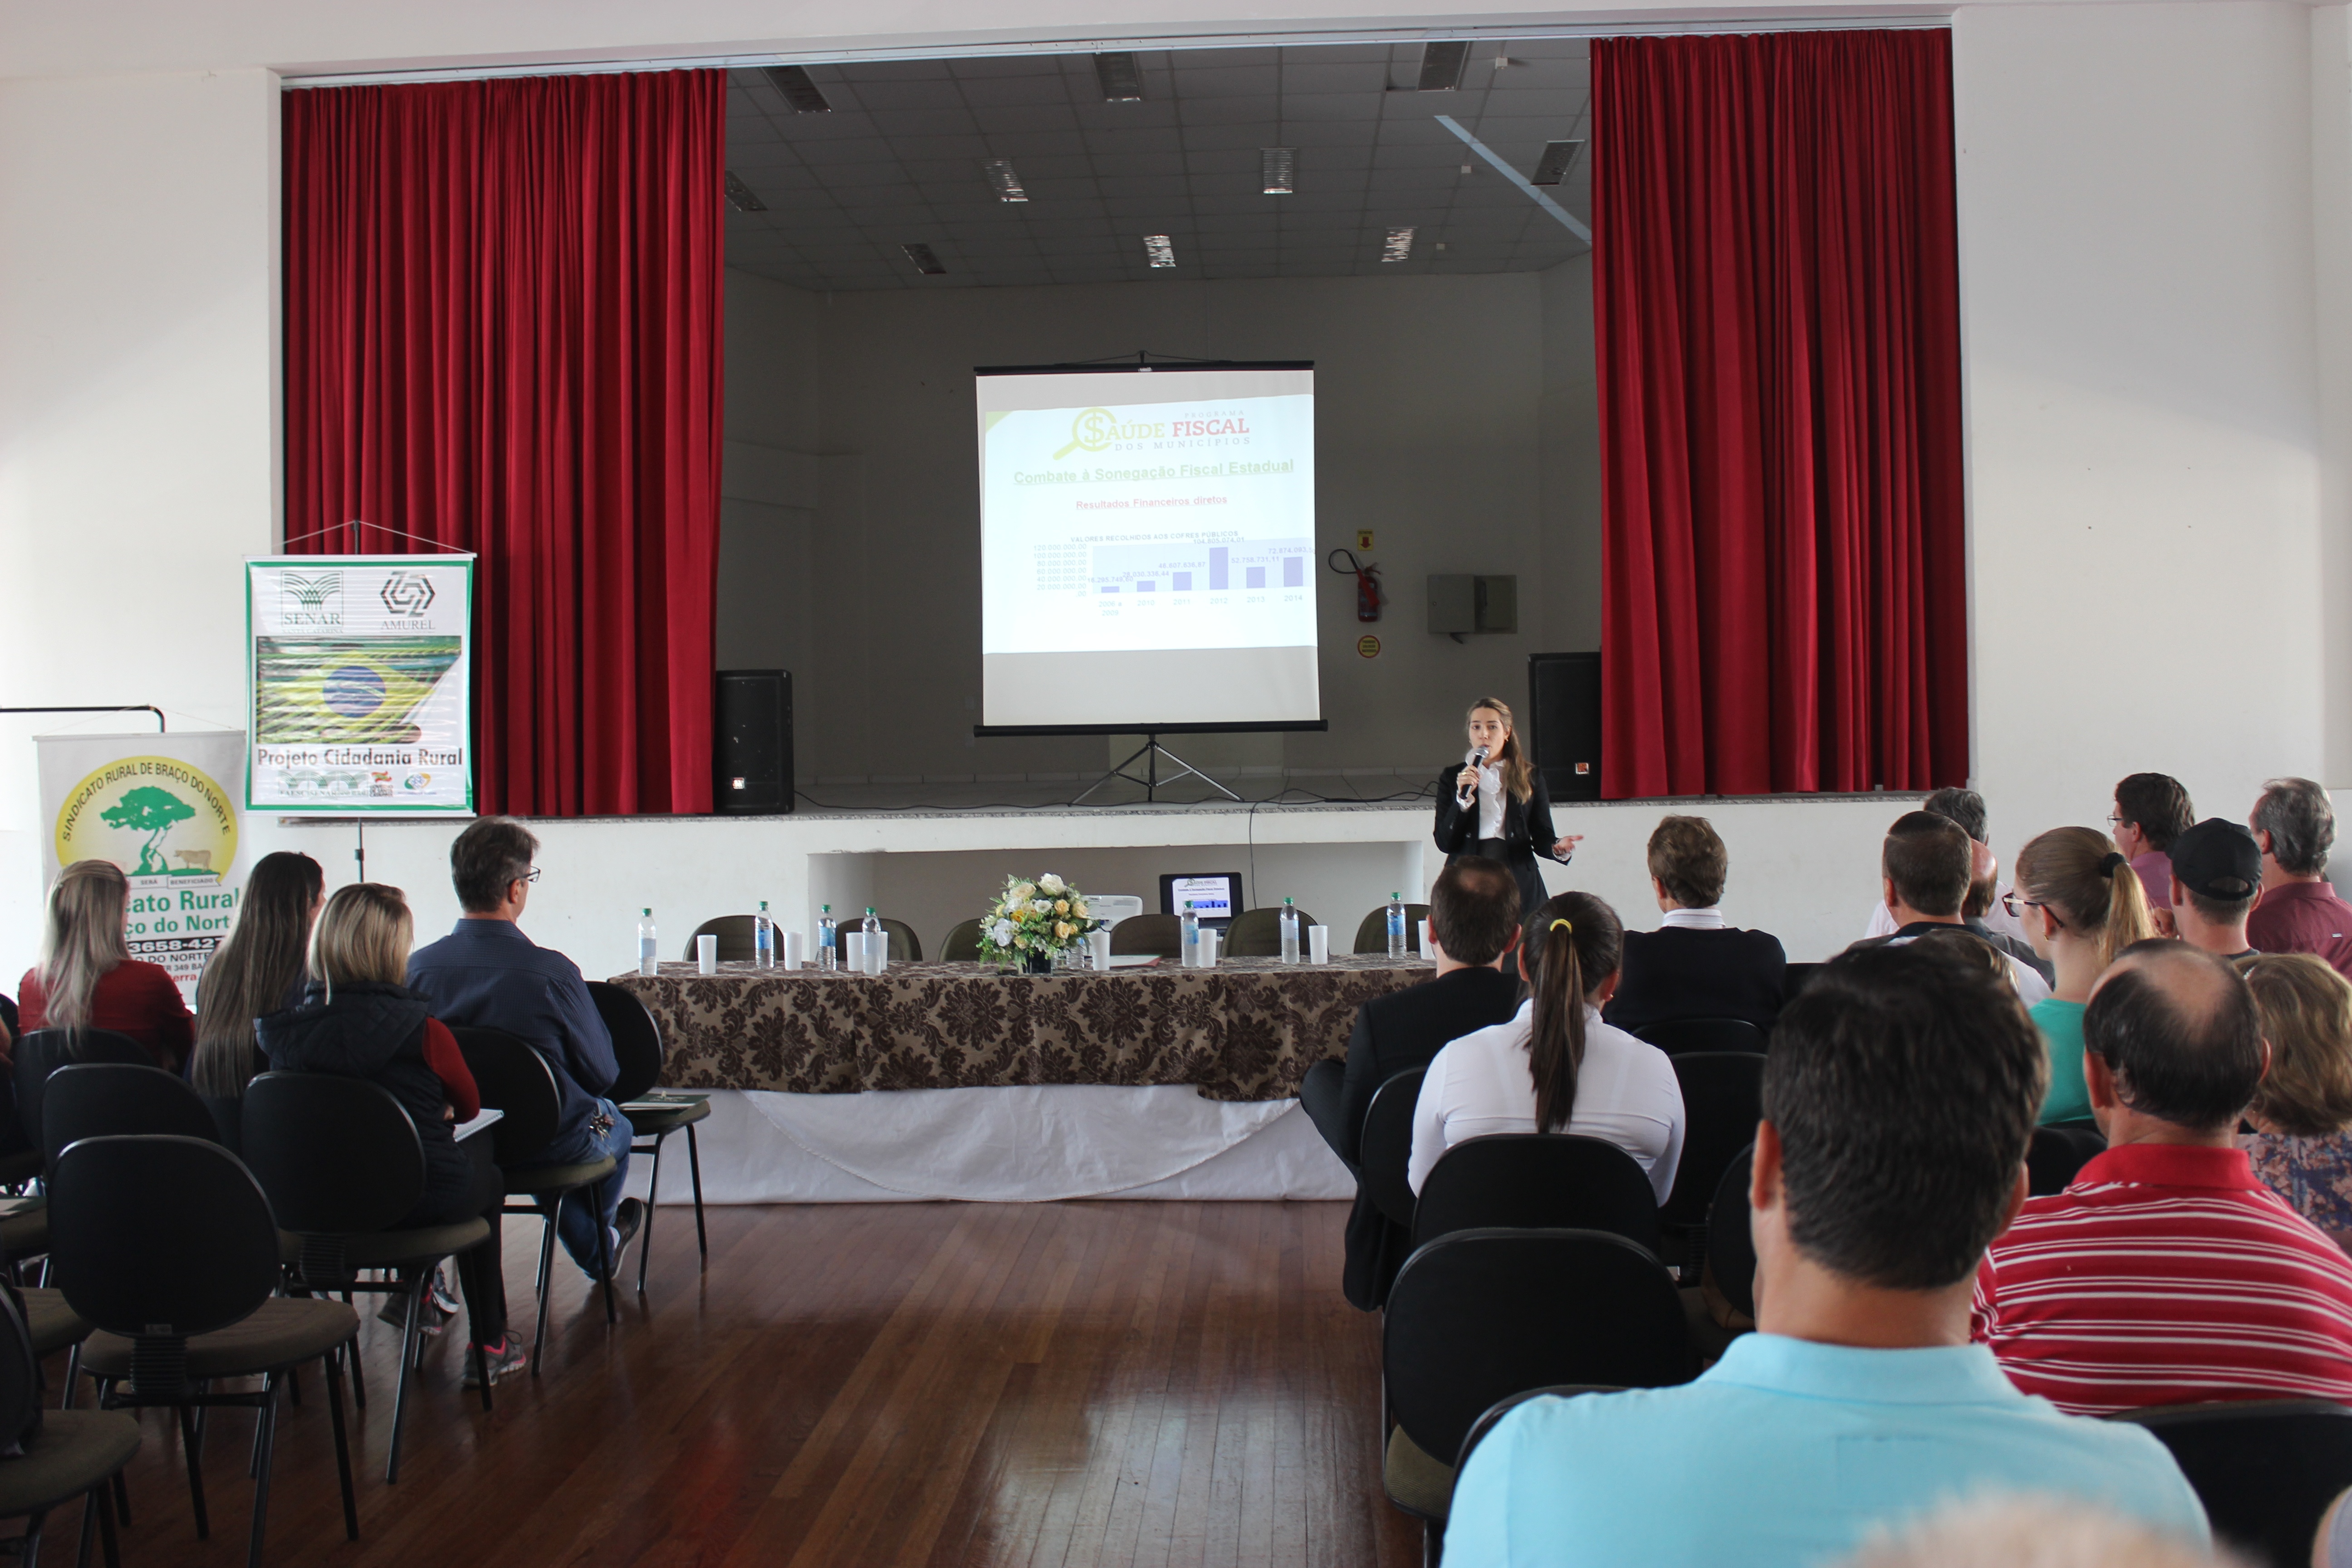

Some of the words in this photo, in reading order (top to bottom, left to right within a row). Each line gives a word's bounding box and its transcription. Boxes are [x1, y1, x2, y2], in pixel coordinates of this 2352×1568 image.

[1185, 410, 1245, 418] PROGRAMA
[1172, 418, 1250, 437] FISCAL
[1115, 442, 1143, 451] DOS
[1154, 436, 1250, 450] MUNICÍPIOS
[1014, 470, 1077, 484] Combate
[1083, 469, 1090, 481] à
[1095, 466, 1176, 482] Sonegação
[1180, 463, 1223, 477] Fiscal
[1229, 459, 1294, 474] Estadual
[1076, 500, 1129, 510] Resultados
[1133, 497, 1190, 507] Financeiros
[1193, 495, 1228, 505] diretos
[284, 612, 341, 625] SENAR
[380, 620, 436, 630] AMUREL
[258, 749, 318, 769] Projeto
[324, 748, 412, 765] Cidadania
[418, 748, 462, 765] Rural
[63, 777, 104, 842] SINDICATO
[106, 764, 137, 784] RURAL
[140, 763, 153, 774] DE
[155, 763, 189, 783] BRAÇO
[191, 776, 204, 793] DO
[205, 788, 230, 835] NORTE
[180, 887, 239, 911] Rural
[154, 917, 178, 933] do
[186, 915, 230, 931] Nort
[148, 955, 166, 963] DO
